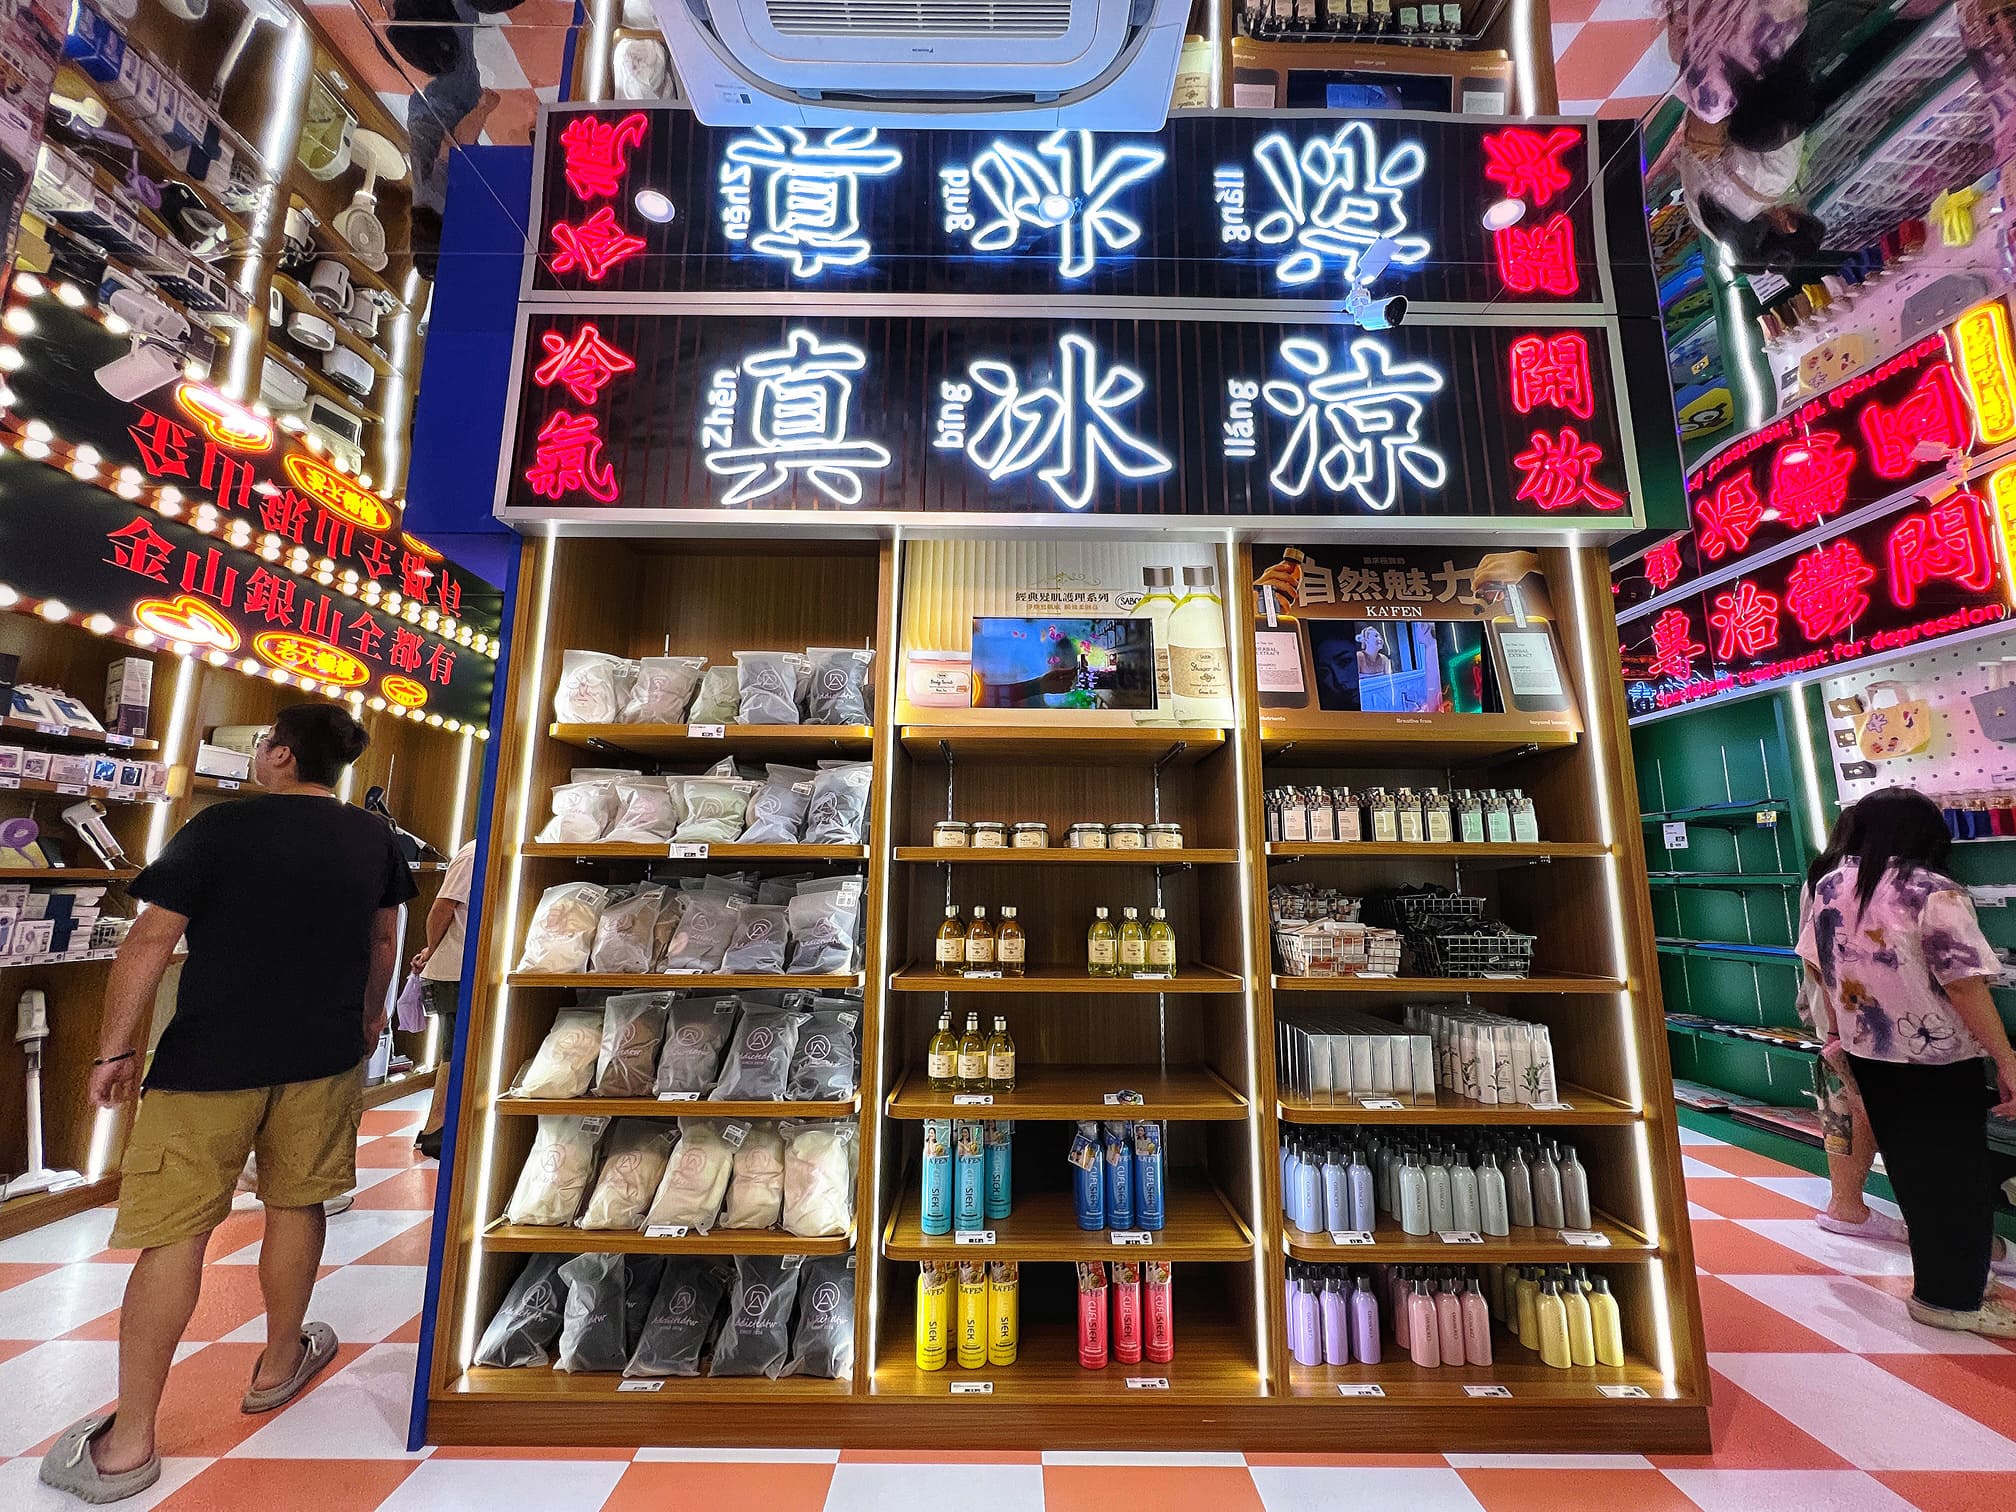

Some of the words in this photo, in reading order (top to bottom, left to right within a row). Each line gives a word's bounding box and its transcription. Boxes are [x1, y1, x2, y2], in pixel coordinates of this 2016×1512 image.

[526, 323, 635, 503] 冷氣
[705, 329, 1448, 511] 真冰涼
[1508, 333, 1629, 511] 開放
[102, 515, 458, 686] 金山銀山全都有
[1298, 557, 1480, 608] 自然魅力
[1365, 605, 1423, 617] KA'FEN
[1739, 648, 1829, 685] treatment
[1833, 641, 1865, 662] for
[1870, 601, 2003, 652] depression
